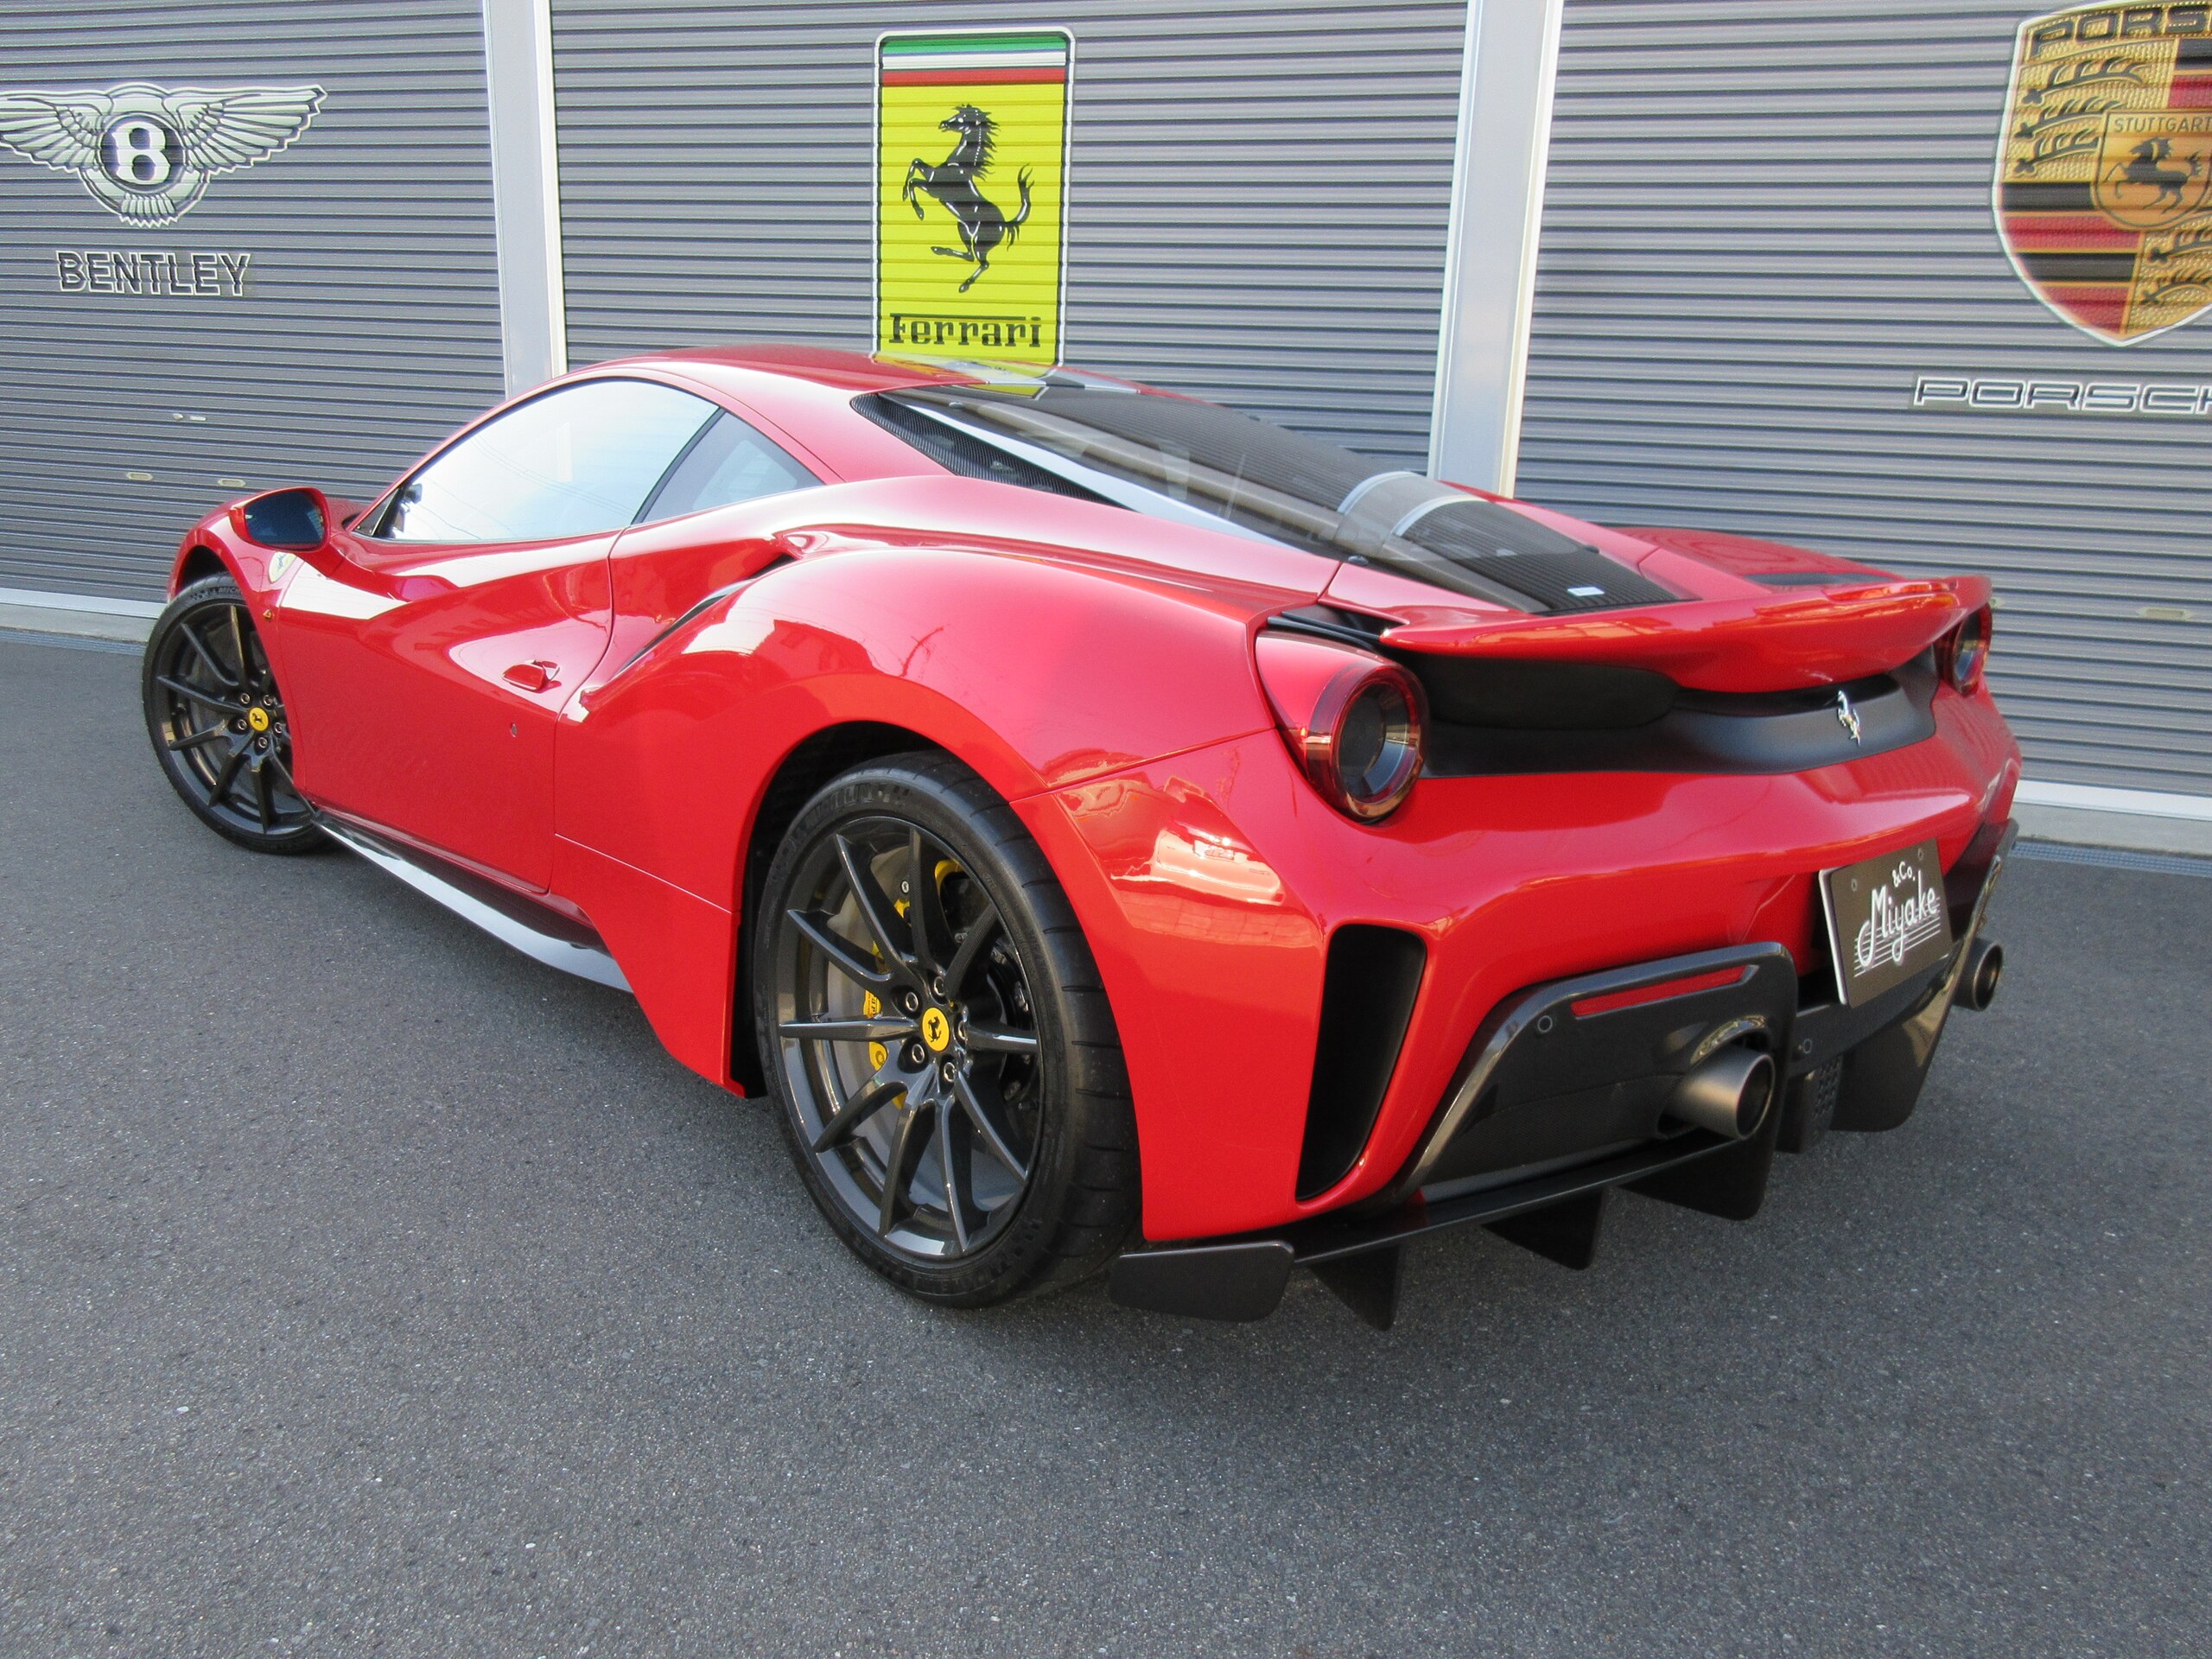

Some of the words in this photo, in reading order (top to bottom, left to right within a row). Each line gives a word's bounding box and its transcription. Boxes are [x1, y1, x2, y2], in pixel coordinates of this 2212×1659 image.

[2031, 5, 2212, 58] PORS
[2113, 116, 2212, 132] STUTTGART
[56, 251, 251, 296] BENTLEY
[888, 313, 1041, 347] Ferrari
[1892, 861, 1916, 887] &Co.
[1858, 869, 1938, 967] Miyake
